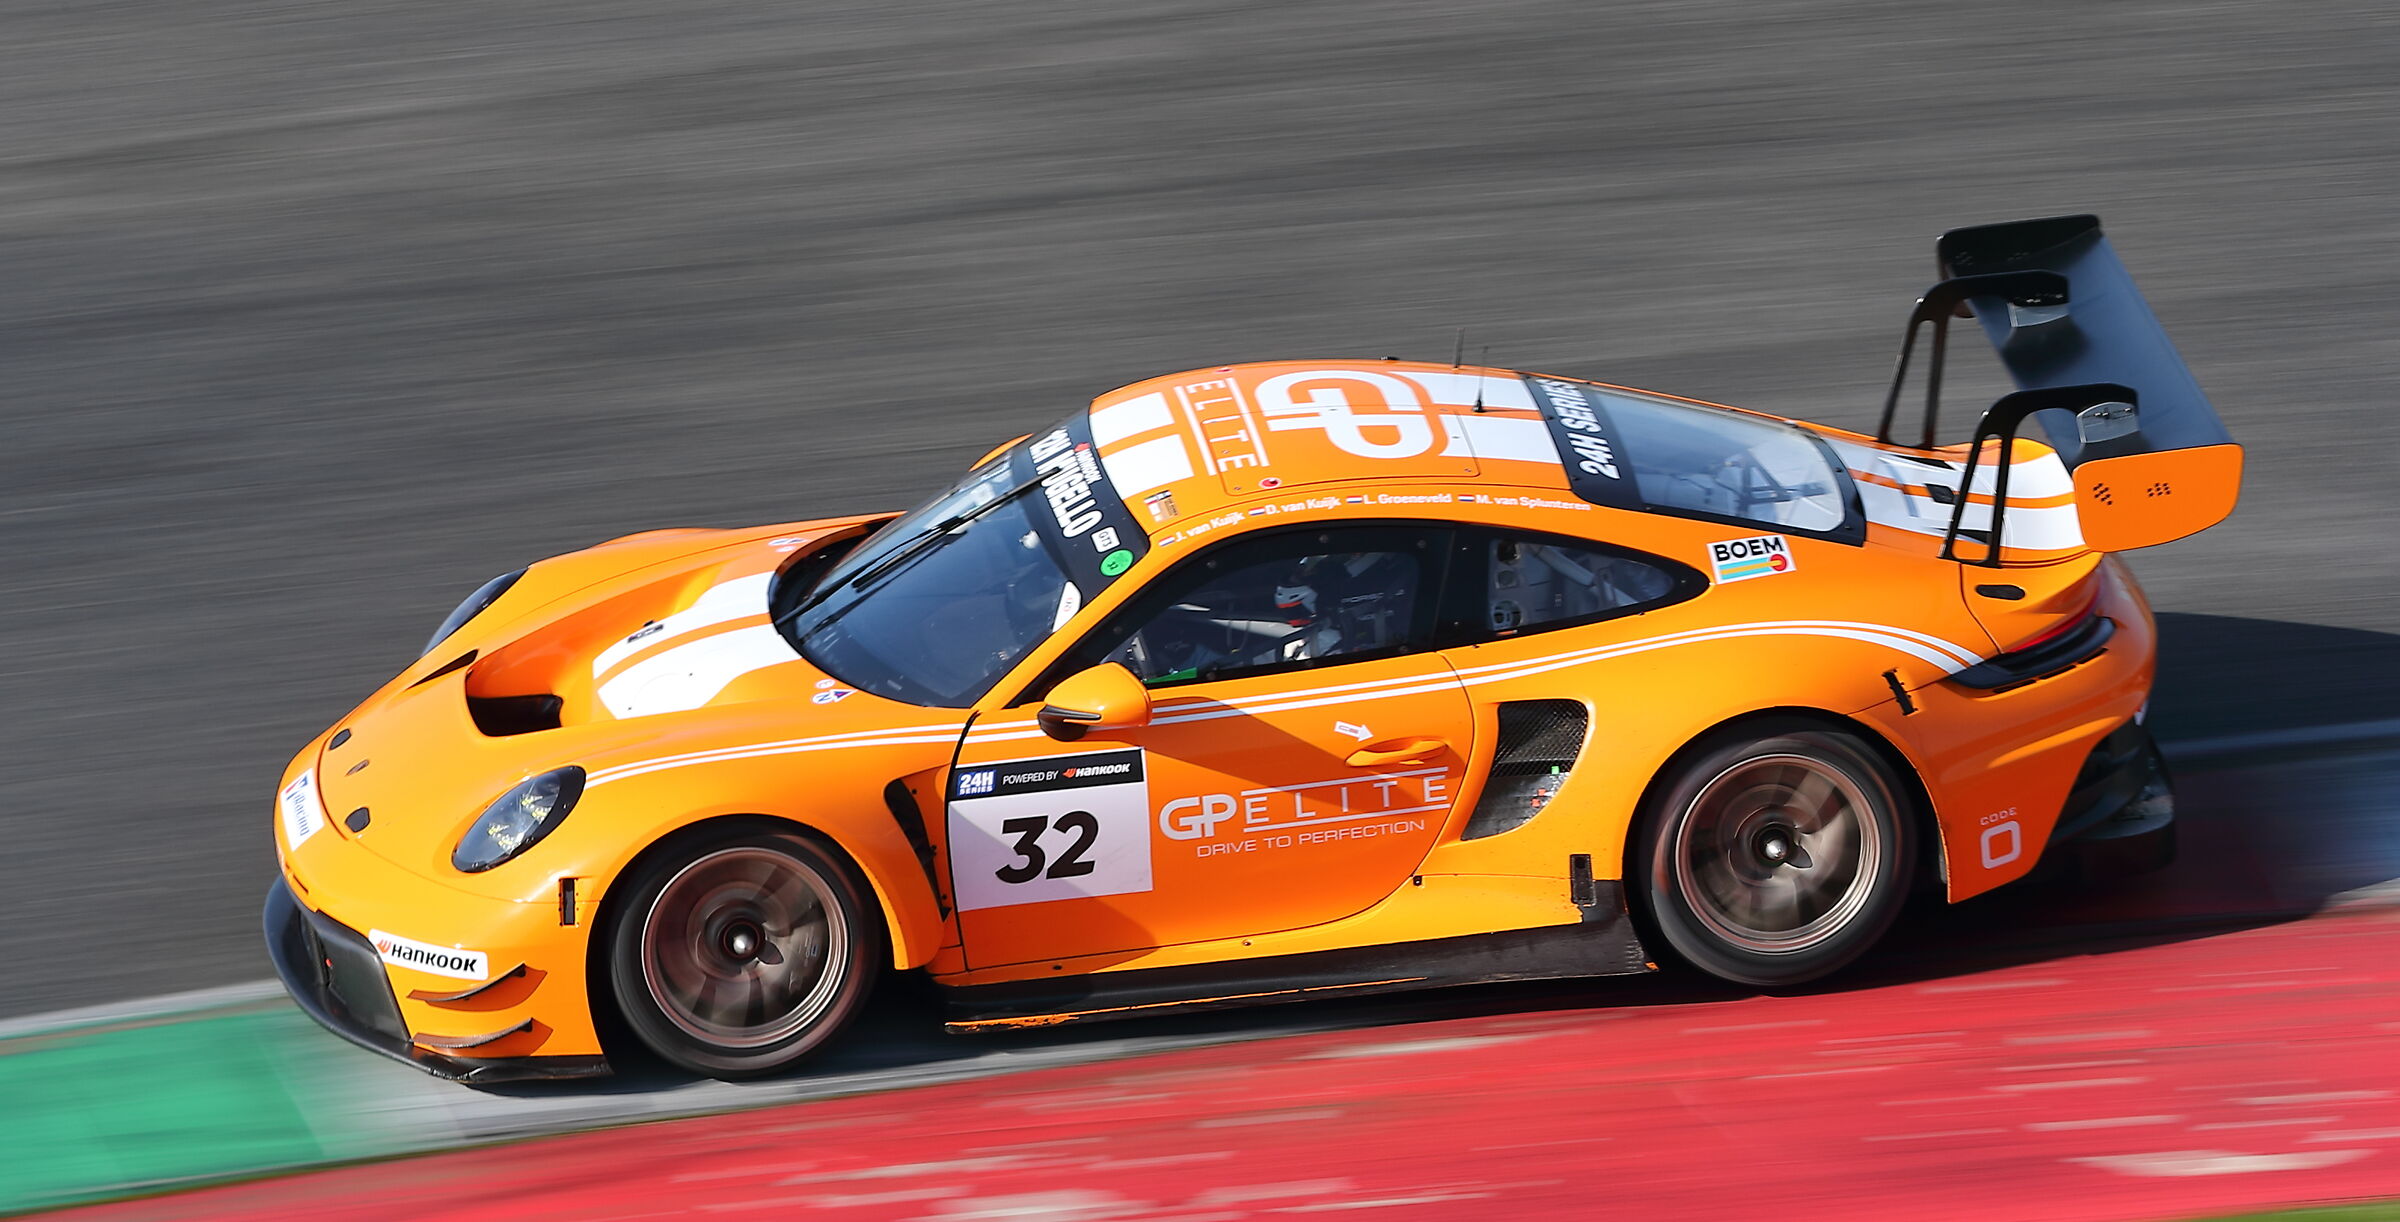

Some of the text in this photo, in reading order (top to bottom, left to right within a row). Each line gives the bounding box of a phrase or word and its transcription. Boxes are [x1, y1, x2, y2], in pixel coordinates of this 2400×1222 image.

[1186, 379, 1258, 473] ELITE
[1535, 378, 1621, 480] 24H SERIES
[1264, 496, 1342, 515] D. van Kuijk
[1364, 493, 1452, 505] L. Groeneveld
[1475, 494, 1592, 511] M. van Splunteren
[1187, 523, 1212, 537] van
[1211, 511, 1246, 528] Kuijk
[1713, 537, 1785, 562] BOEM
[959, 770, 994, 789] 24H
[1002, 772, 1045, 785] POWERED
[1046, 770, 1059, 780] BY
[959, 786, 993, 796] SERIES
[1159, 774, 1449, 841] GP ELITE
[1980, 806, 2017, 826] CODE
[995, 810, 1098, 884] 32
[1197, 819, 1426, 858] DRIVE TO PERFECTION
